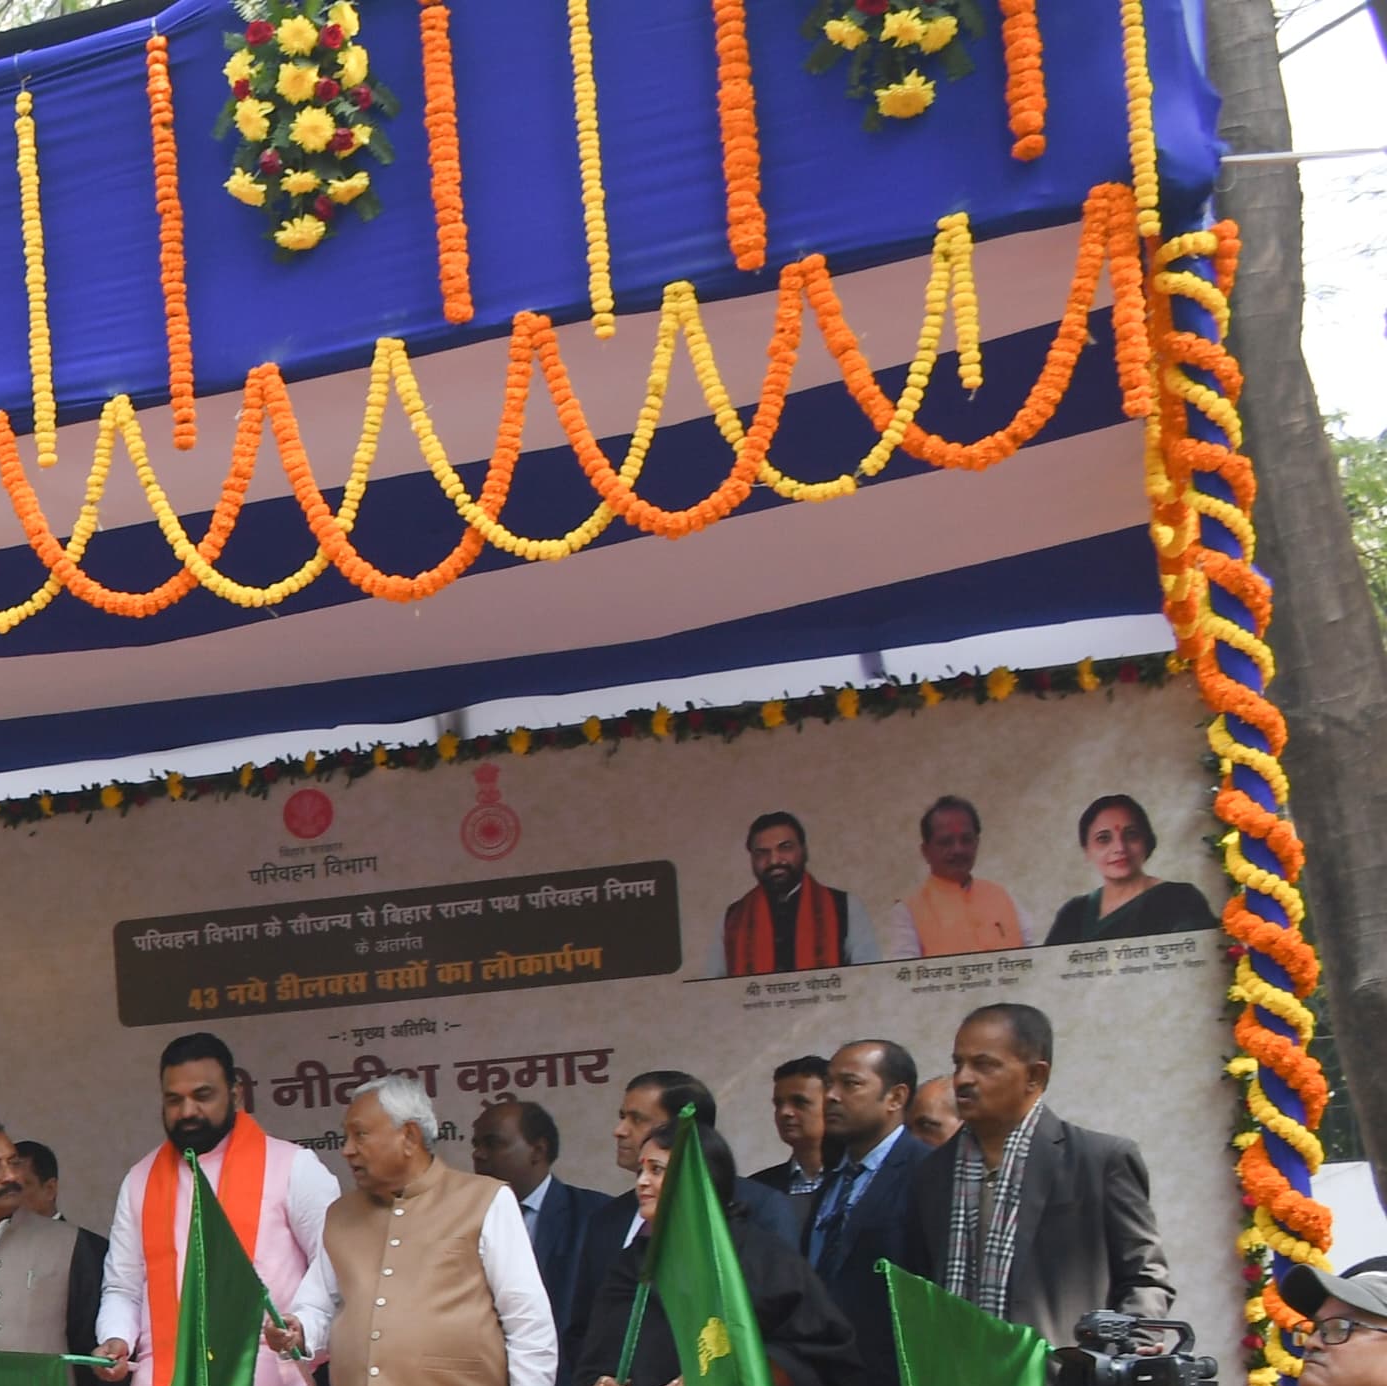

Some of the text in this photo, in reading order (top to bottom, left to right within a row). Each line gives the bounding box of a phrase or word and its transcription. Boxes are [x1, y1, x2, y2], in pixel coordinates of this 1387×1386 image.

[247, 855, 378, 885] परिवहन विभाग
[132, 877, 656, 951] परिवहन विभाग के सौजन्य से बिहार राज्य पथ परिवहन निगम
[355, 931, 423, 955] के अंतर्गत
[1114, 944, 1149, 960] शीला
[1154, 937, 1196, 960] कुमारी
[188, 942, 603, 1010] 43 नये डीलक्स बसों का लोकार्पण
[916, 965, 953, 981] विजय
[957, 961, 993, 981] कुमार
[350, 1026, 385, 1047] मुख्य
[390, 1017, 437, 1037] अतिथि
[454, 1048, 614, 1104] कुमार
